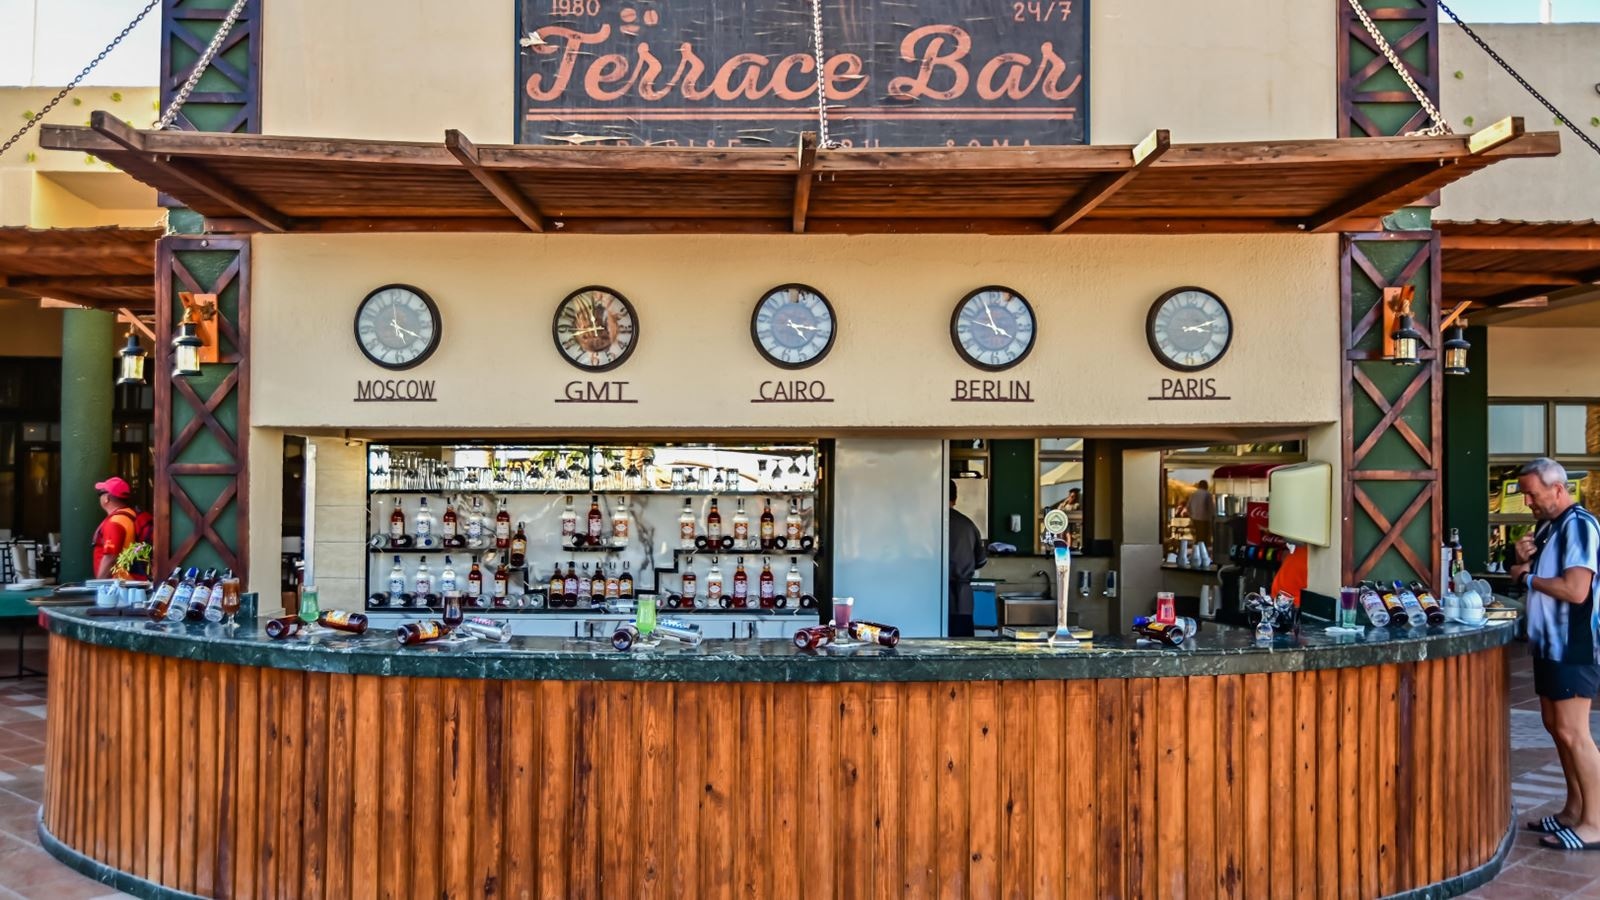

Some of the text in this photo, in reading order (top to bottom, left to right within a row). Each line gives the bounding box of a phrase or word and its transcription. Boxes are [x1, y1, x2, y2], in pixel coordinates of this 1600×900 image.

[552, 0, 601, 17] 1980
[1013, 1, 1072, 22] 24/7
[526, 23, 1082, 101] Terrace Bar
[357, 379, 436, 400] MOSCOW
[564, 380, 629, 400] GMT
[759, 380, 826, 400] CAIRO
[954, 379, 1030, 400] BERLIN
[1161, 378, 1217, 399] PARIS
